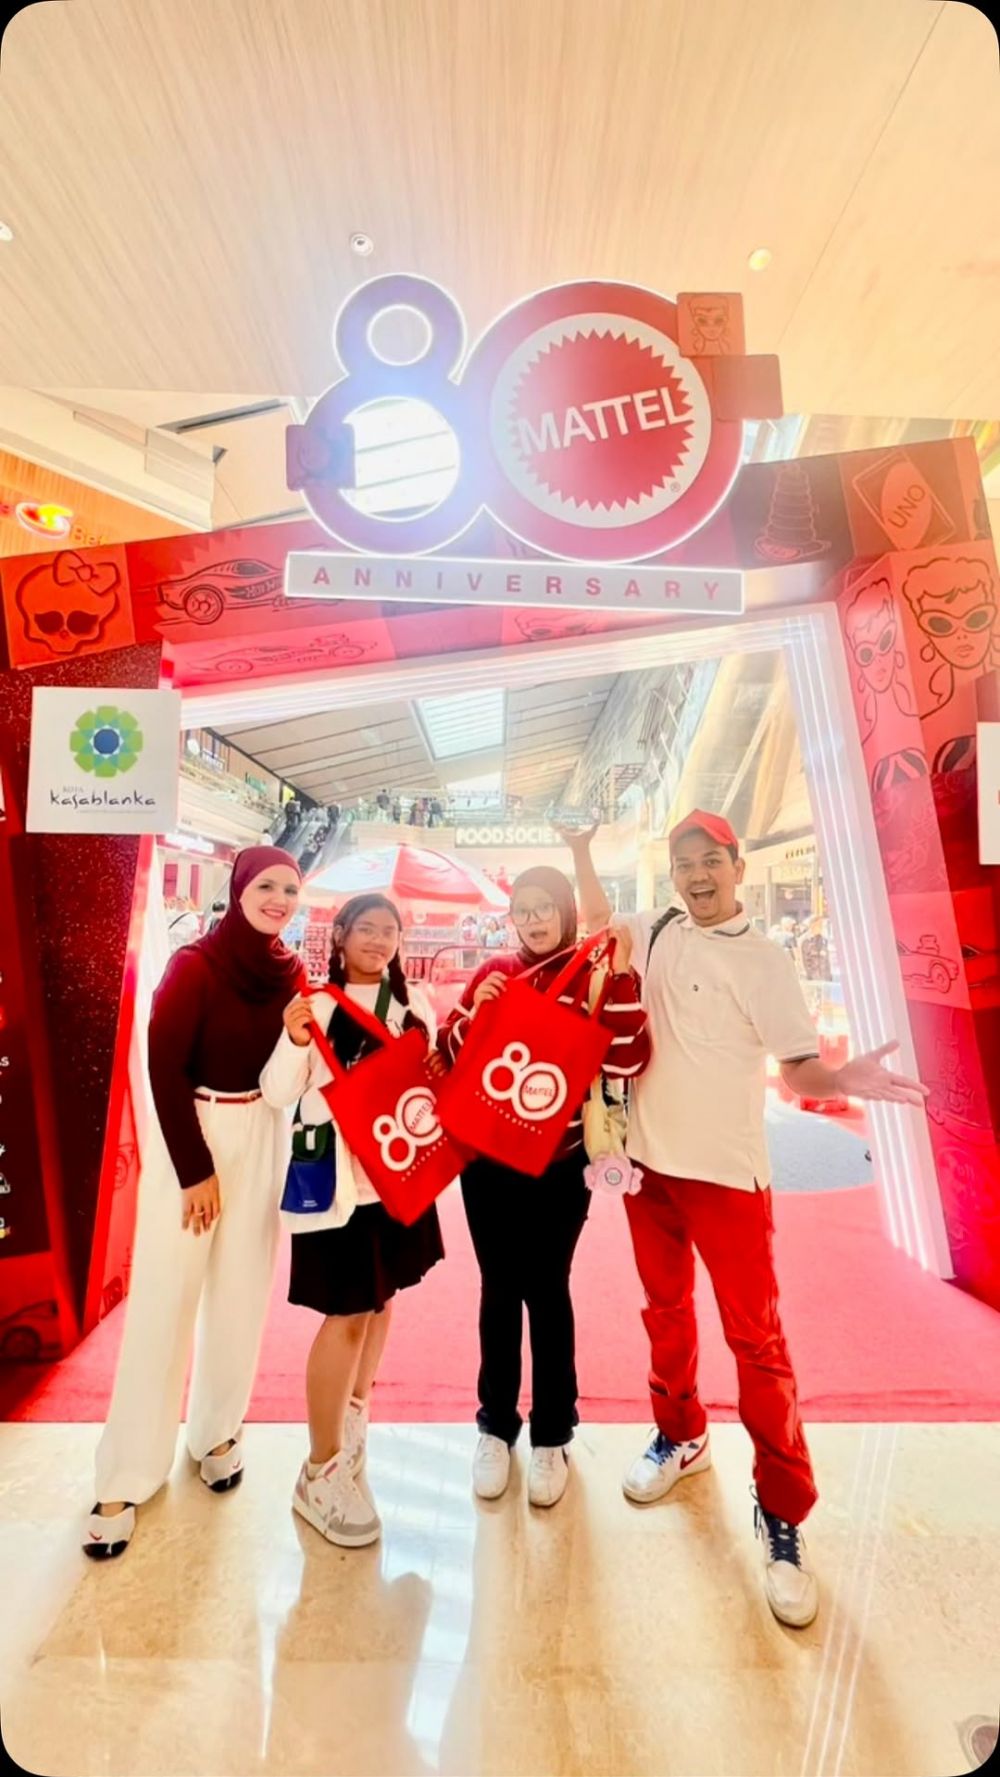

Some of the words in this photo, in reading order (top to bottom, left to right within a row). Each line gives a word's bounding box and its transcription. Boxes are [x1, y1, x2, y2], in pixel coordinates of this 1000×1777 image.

[518, 386, 692, 456] MATTEL
[887, 484, 926, 528] UNO
[313, 566, 719, 601] ANNIVERSARY
[455, 827, 504, 844] FOOD
